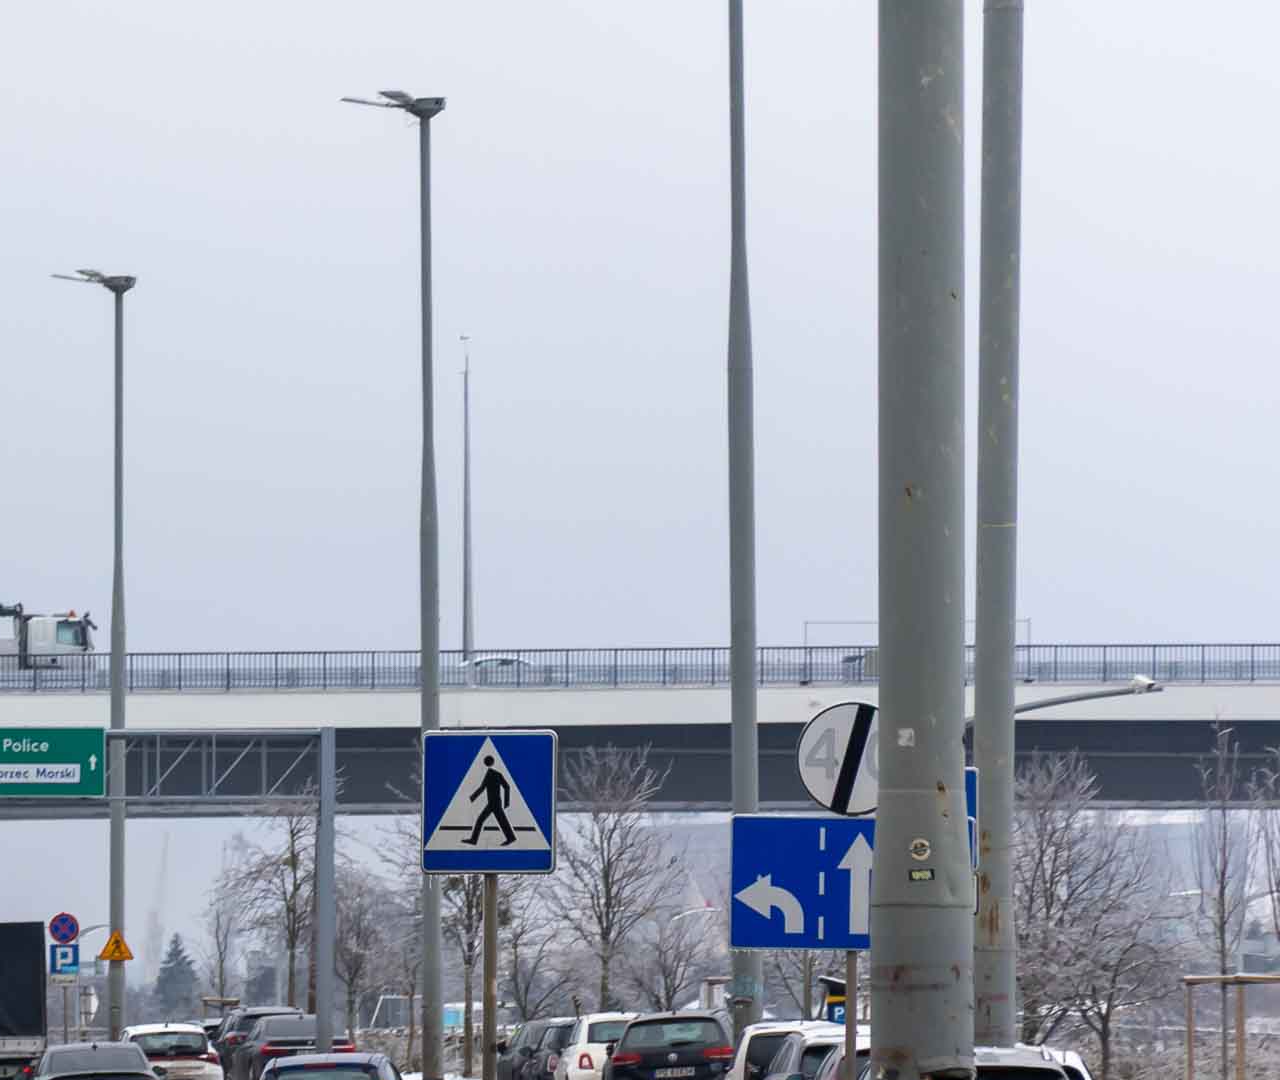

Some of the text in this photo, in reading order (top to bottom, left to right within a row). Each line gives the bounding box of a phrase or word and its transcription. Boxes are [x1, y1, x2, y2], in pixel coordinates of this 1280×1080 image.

[2, 738, 50, 753] Police
[36, 766, 77, 779] Morski
[834, 1006, 845, 1021] P
